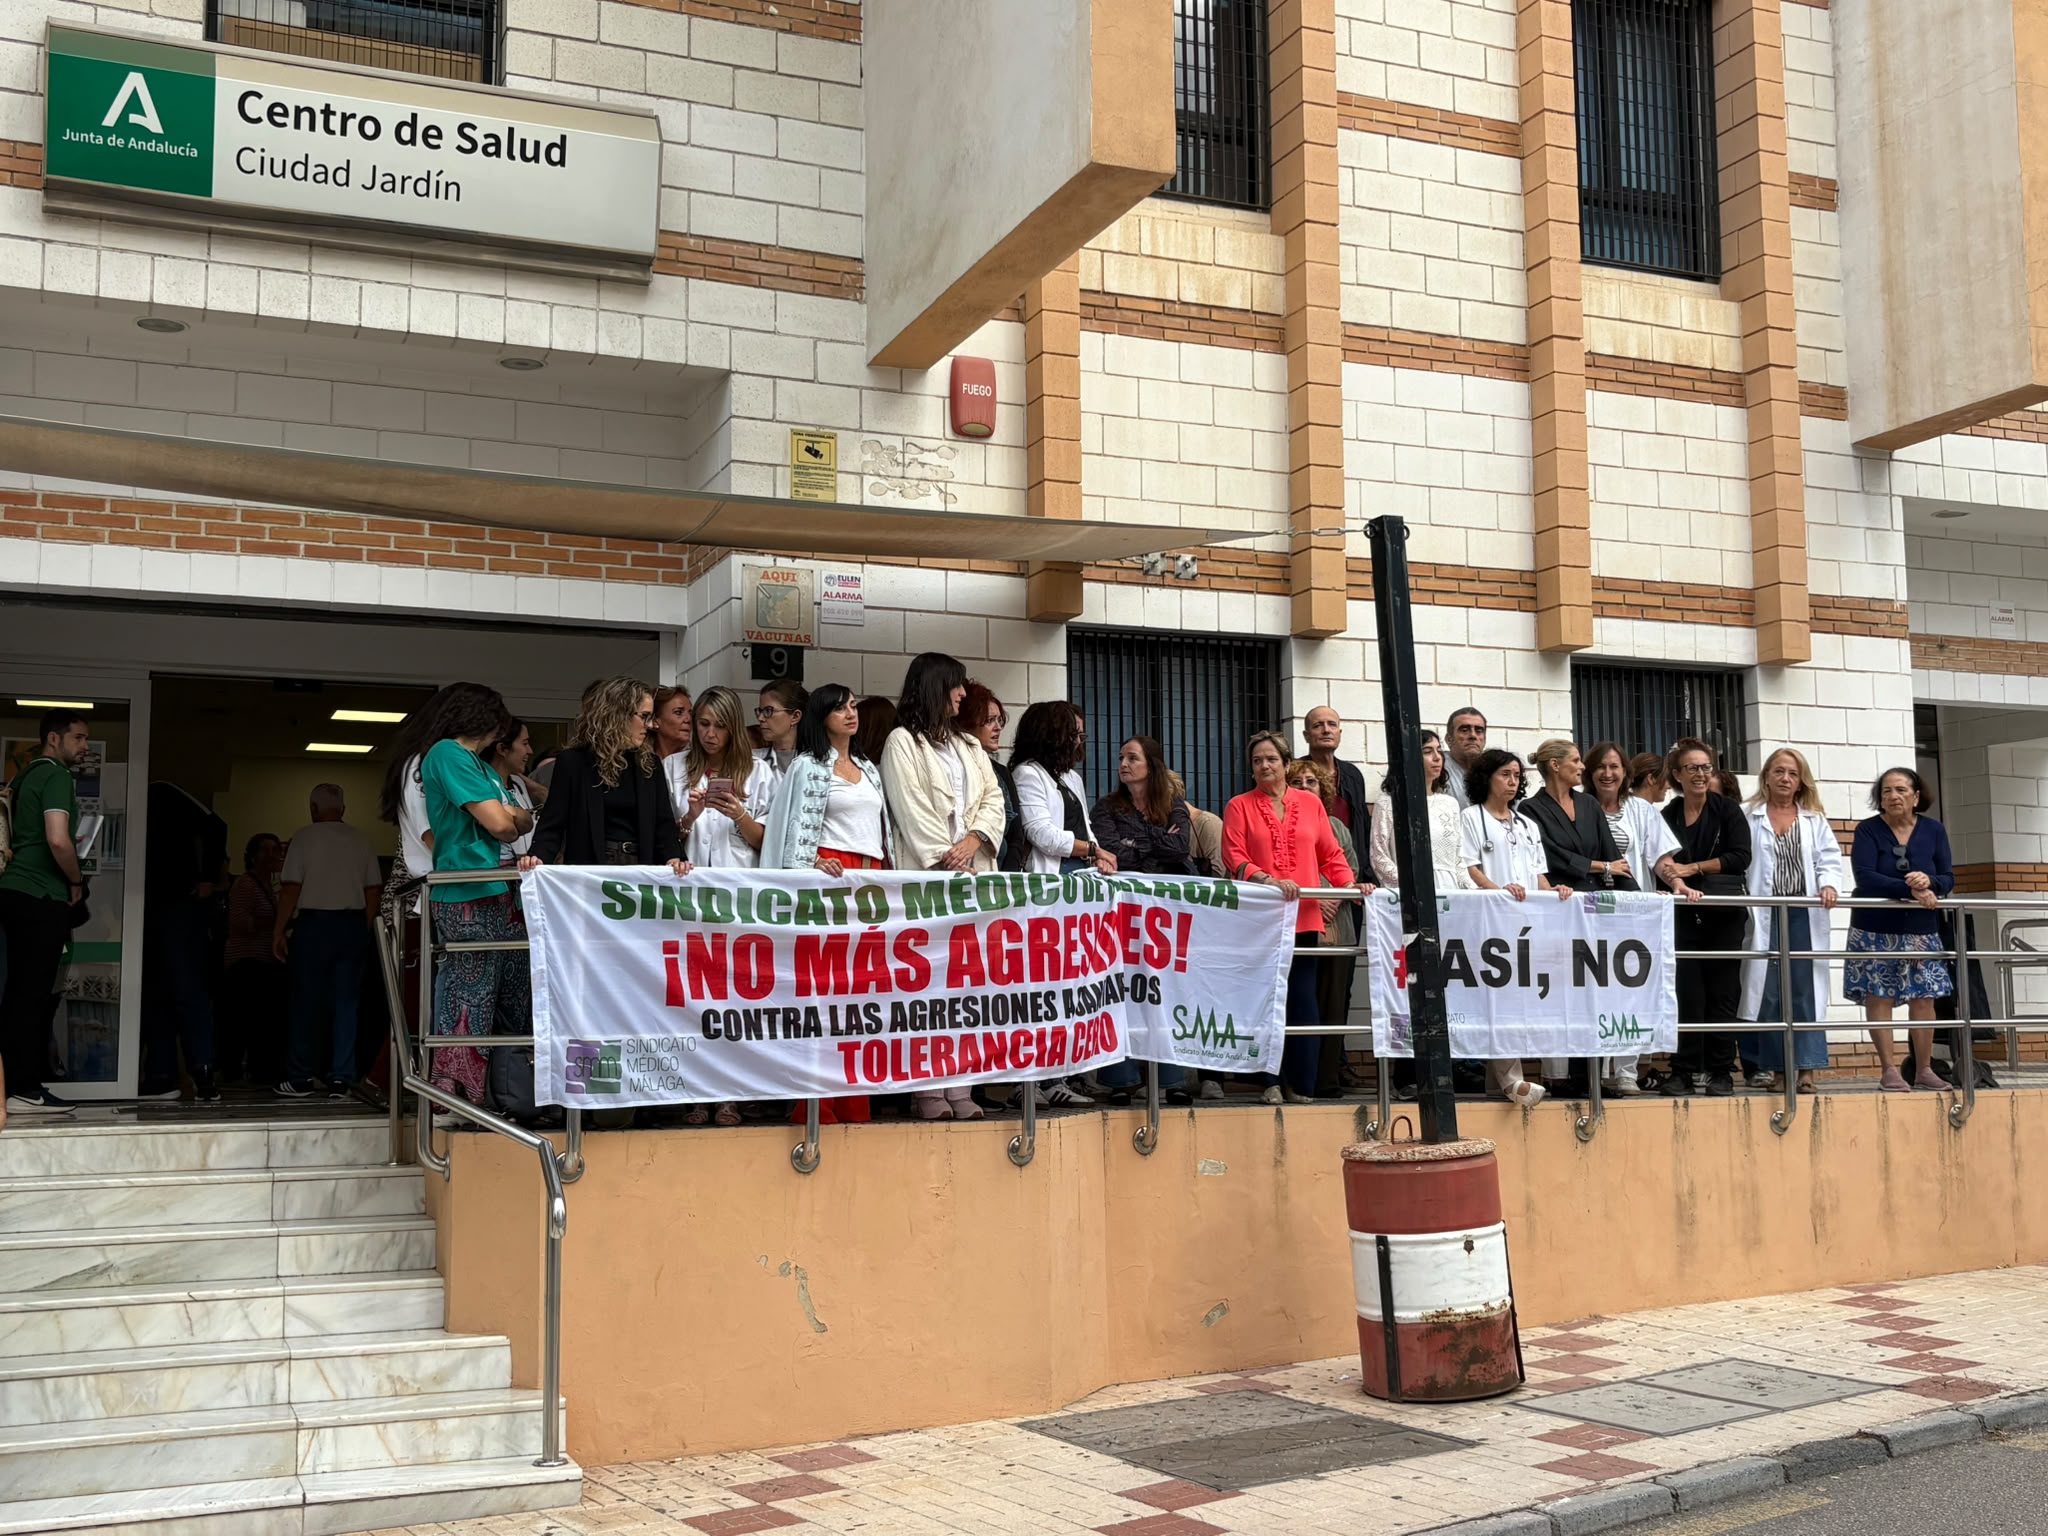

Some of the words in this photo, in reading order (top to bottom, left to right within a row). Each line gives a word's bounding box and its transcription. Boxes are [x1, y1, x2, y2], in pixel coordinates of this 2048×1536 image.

[237, 90, 382, 141] Centro
[394, 112, 444, 150] de
[455, 121, 567, 168] Salud
[62, 128, 104, 145] Junta
[106, 134, 125, 147] de
[127, 136, 198, 158] Andalucía
[235, 146, 351, 188] Ciudad
[361, 164, 461, 202] Jardín
[962, 383, 992, 398] FUEGO
[760, 570, 798, 583] AQUI
[837, 575, 861, 583] EULEN
[822, 591, 863, 601] ALARMA
[745, 630, 812, 644] VACUNAS
[770, 647, 788, 677] 9
[601, 880, 890, 926] SINDICATO
[902, 872, 1078, 920] MÉDICO
[662, 932, 777, 1008] ¡NO
[794, 925, 932, 997] MÁS
[1572, 939, 1652, 988] NO
[702, 1005, 822, 1041] CONTRA
[829, 1002, 884, 1036] LAS
[889, 989, 1059, 1033] AGRESIONES
[626, 1036, 697, 1054] SINDICATO
[837, 1024, 1068, 1084] TOLERANCIA
[1173, 1045, 1200, 1056] Sindicato
[1201, 1049, 1224, 1059] Médico
[1225, 1052, 1251, 1061] Andaluz
[626, 1055, 680, 1073] MÉDICO
[629, 1075, 686, 1093] MÁLAGA
